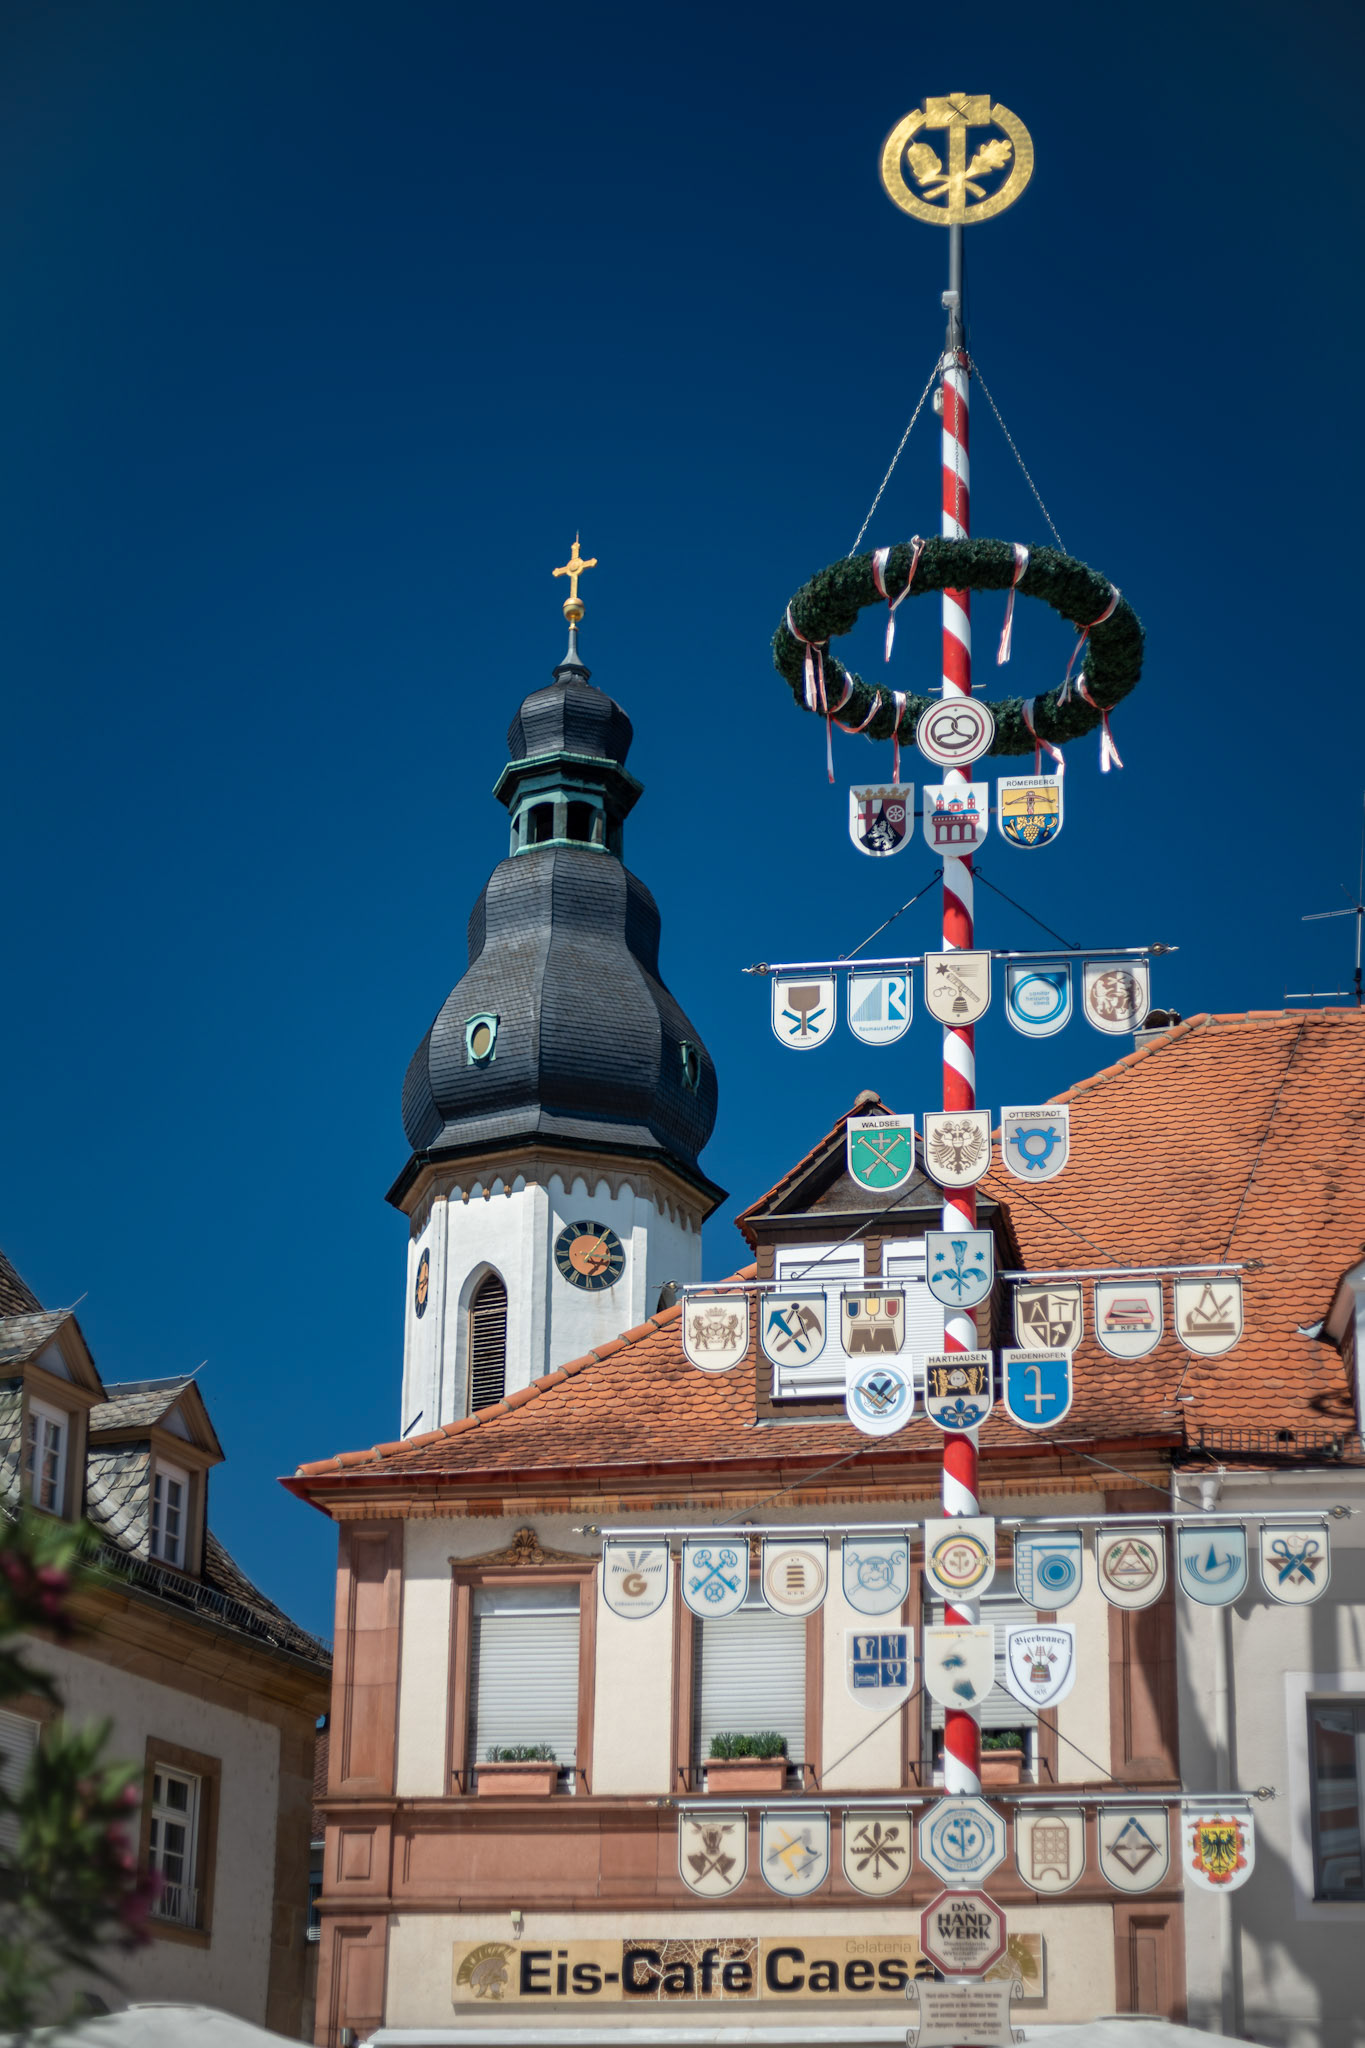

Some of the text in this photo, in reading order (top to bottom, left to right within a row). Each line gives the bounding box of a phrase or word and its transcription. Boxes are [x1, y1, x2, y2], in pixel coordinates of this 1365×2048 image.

[1006, 779, 1055, 787] RÖMERBERG
[1009, 1110, 1061, 1119] OTTERSTADT
[862, 1120, 900, 1128] WALDSEE
[928, 1354, 987, 1363] HARTHAUSEN
[1010, 1352, 1066, 1360] DUDENHOFEN
[1014, 1635, 1067, 1646] Bierbrauer
[951, 1902, 976, 1912] DAS
[937, 1913, 992, 1927] HAND
[937, 1926, 991, 1940] WERK
[845, 1940, 912, 1953] Gelateria
[519, 1947, 946, 1995] Eis-Café Caesa
